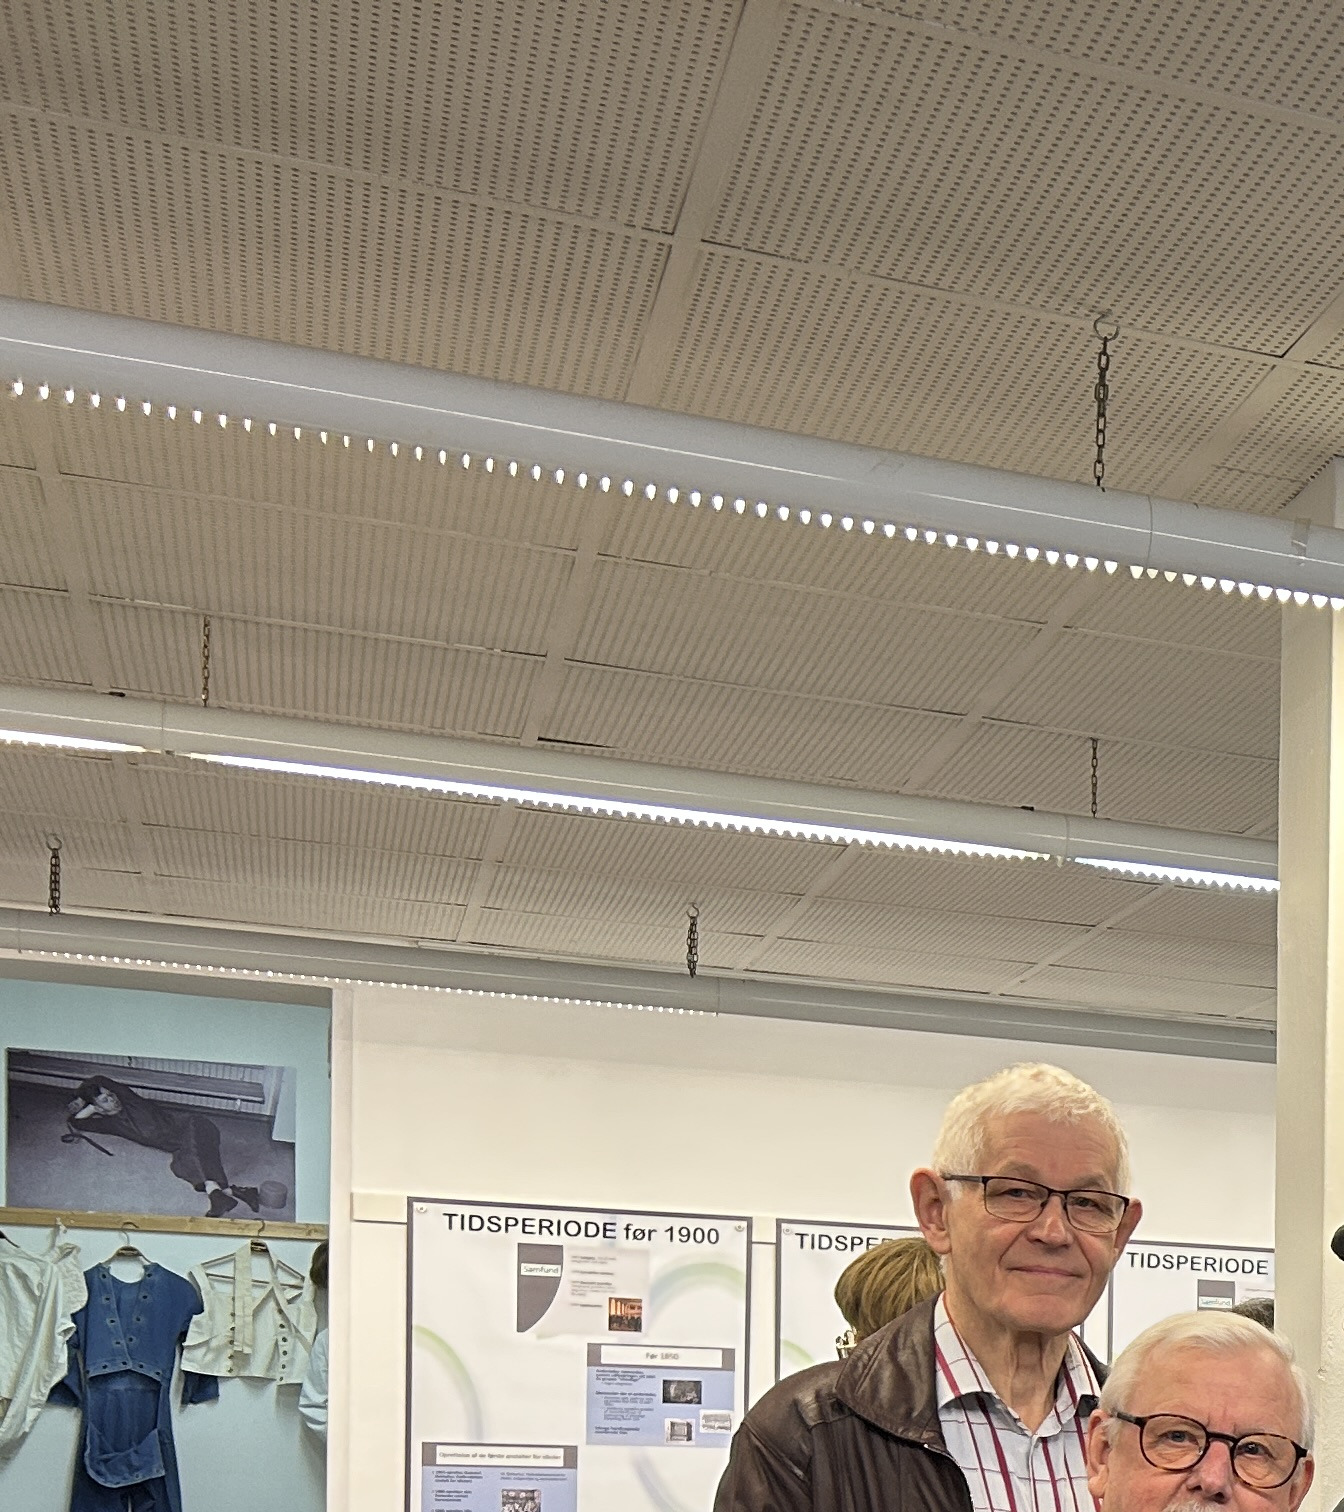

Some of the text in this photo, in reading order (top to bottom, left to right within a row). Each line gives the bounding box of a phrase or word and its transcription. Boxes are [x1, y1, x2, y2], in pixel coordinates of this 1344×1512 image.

[442, 1212, 720, 1245] TIDSPERIODE før 1900
[795, 1233, 894, 1252] TIDSPE
[1126, 1252, 1269, 1276] TIDSPERIODE
